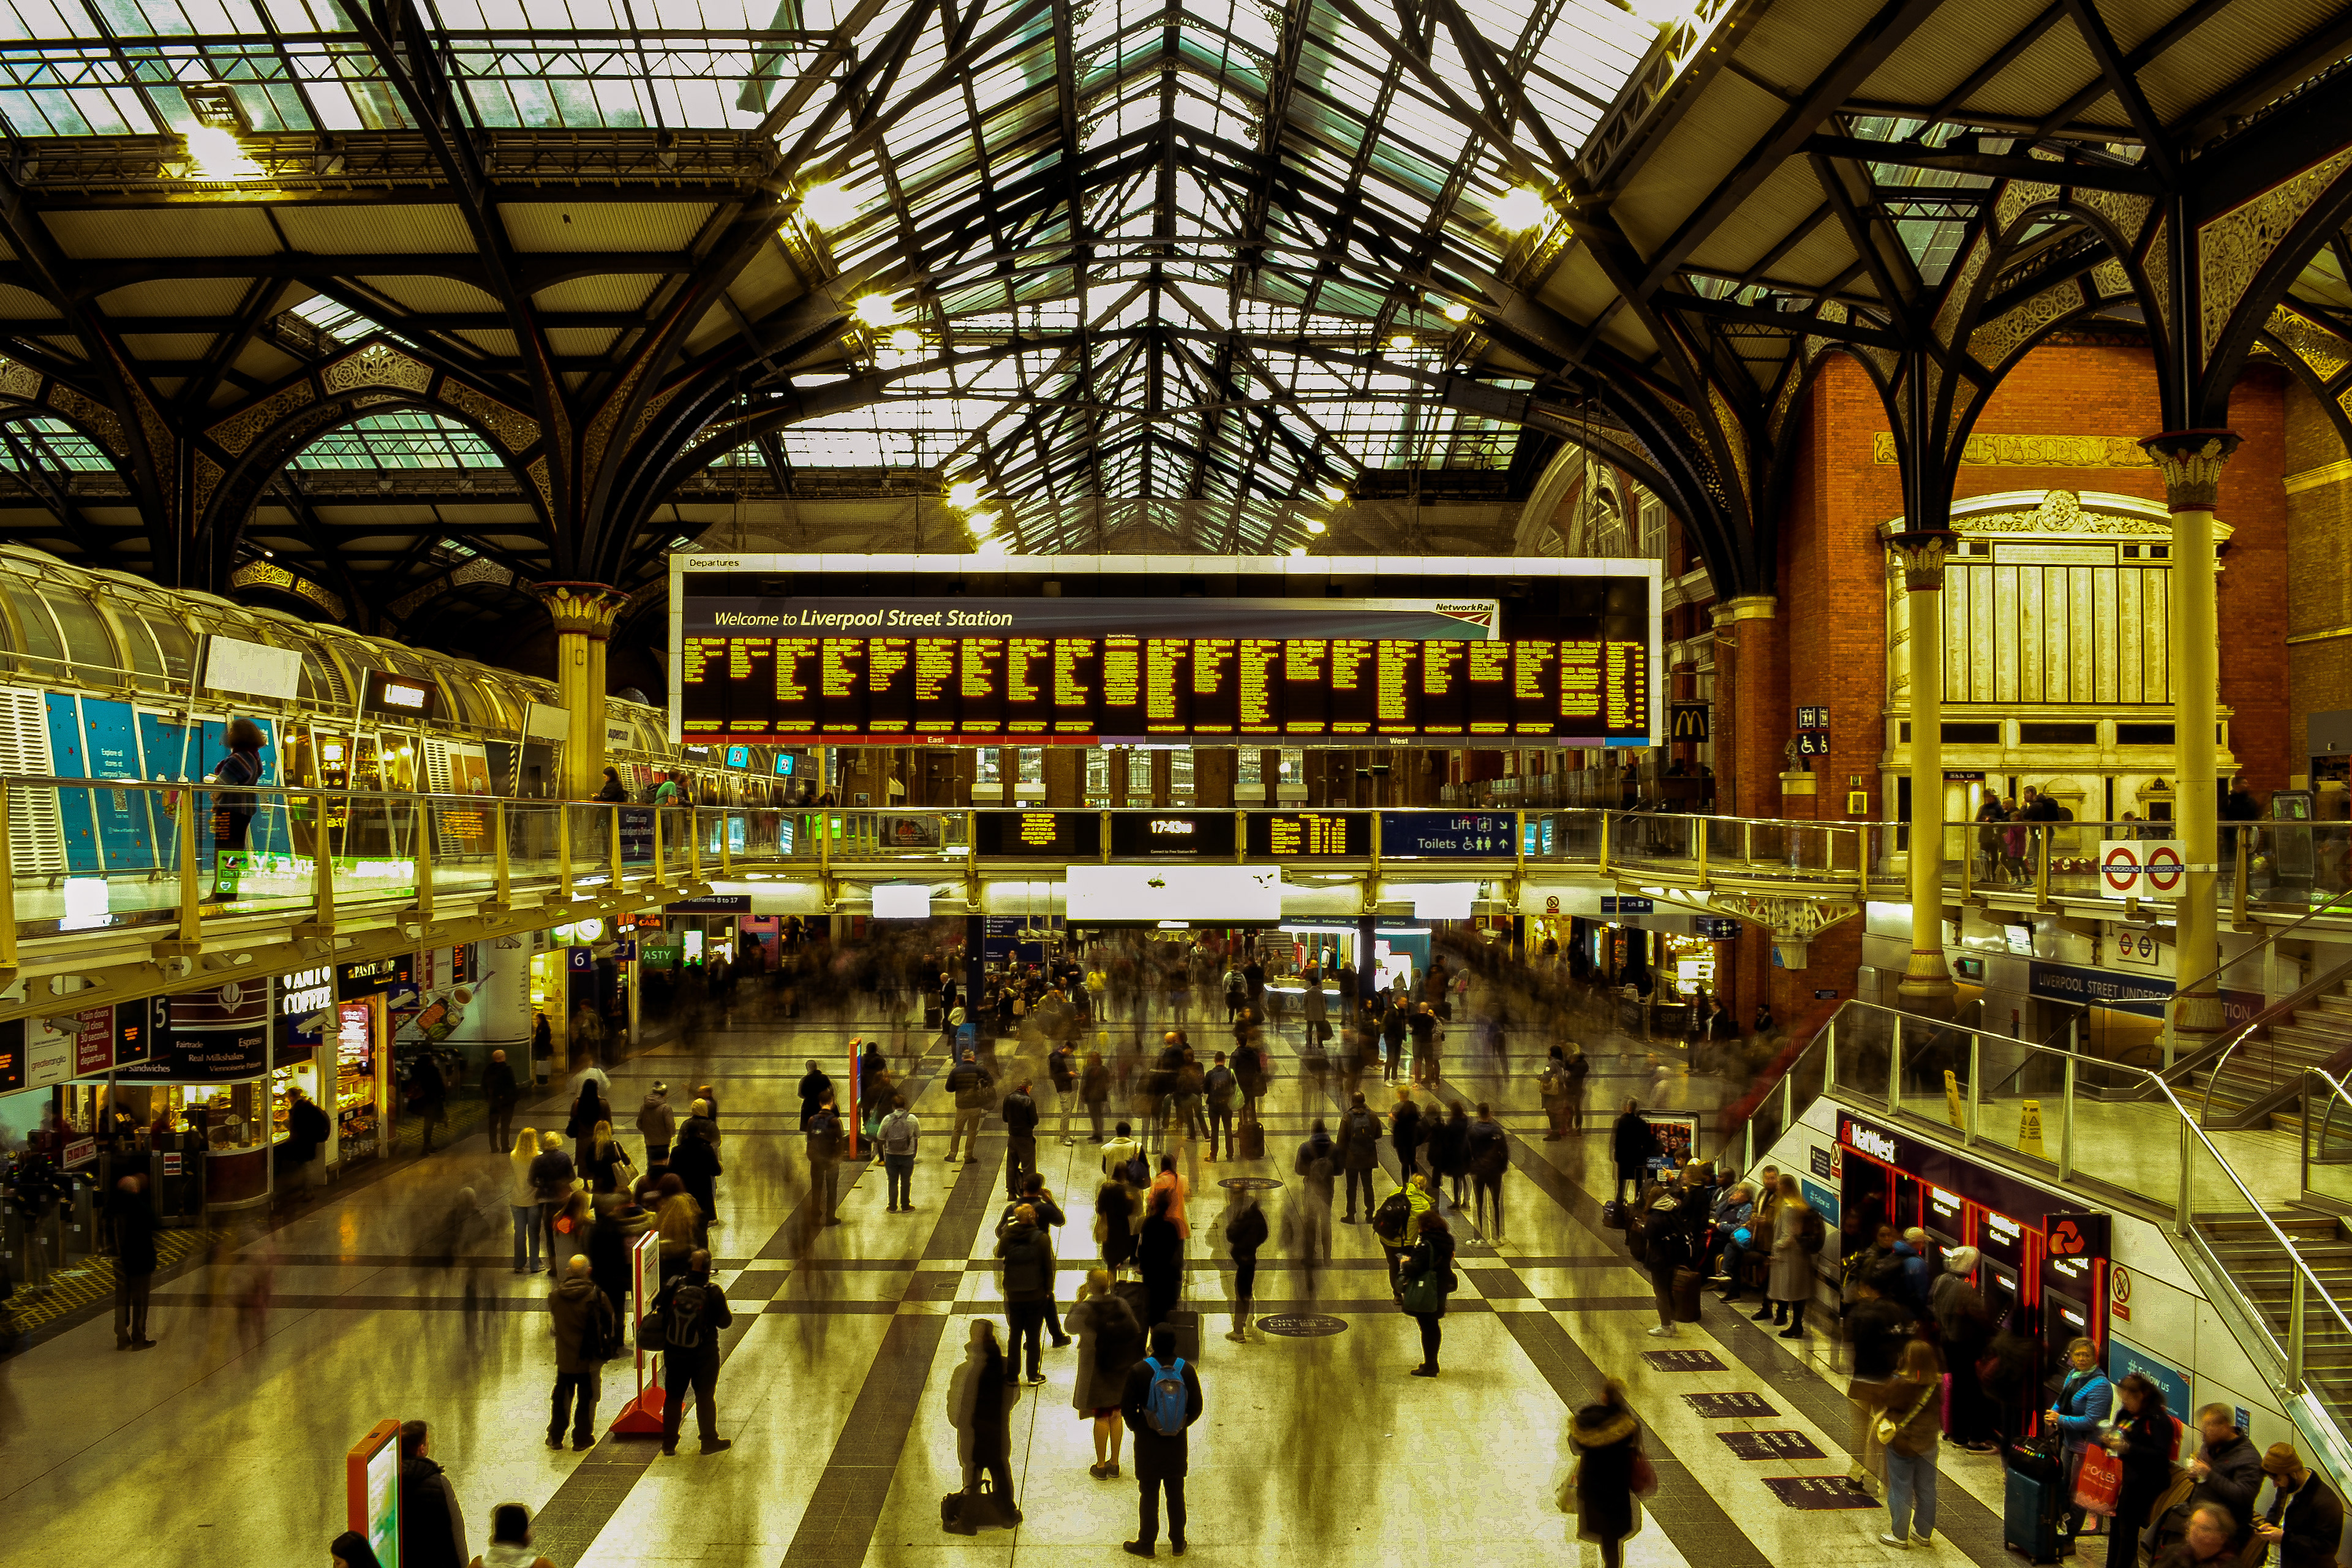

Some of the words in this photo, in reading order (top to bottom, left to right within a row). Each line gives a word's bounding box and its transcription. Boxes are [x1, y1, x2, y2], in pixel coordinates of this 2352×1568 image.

[1996, 439, 2101, 462] EASTERN
[690, 559, 739, 568] Departures
[715, 612, 779, 626] Welcome
[783, 613, 797, 626] to
[800, 609, 884, 631] Liverpool
[887, 609, 942, 627] Street
[946, 609, 1013, 627] Station
[1451, 819, 1471, 831] Lift
[1418, 837, 1457, 850] Toilets
[575, 952, 584, 967] 6
[641, 950, 671, 960] ASTY
[355, 963, 376, 979] PASTY
[2039, 973, 2083, 992] LIVERPOOL
[2087, 981, 2119, 998] STREET
[283, 986, 331, 1016] COFFEE
[80, 1011, 93, 1022] Train
[94, 1009, 108, 1019] doors
[155, 998, 167, 1028] 5
[2222, 1002, 2251, 1020] TION
[91, 1021, 104, 1030] close
[88, 1031, 109, 1042] seconds
[80, 1044, 98, 1055] before
[80, 1053, 106, 1066] departure
[206, 1052, 244, 1061] Milkshakes
[128, 1064, 171, 1072] Sandwiches
[1852, 1123, 1895, 1164] NatWest
[2160, 1381, 2170, 1393] us
[1796, 1479, 1815, 1491] here
[1814, 1478, 1838, 1496] queue
